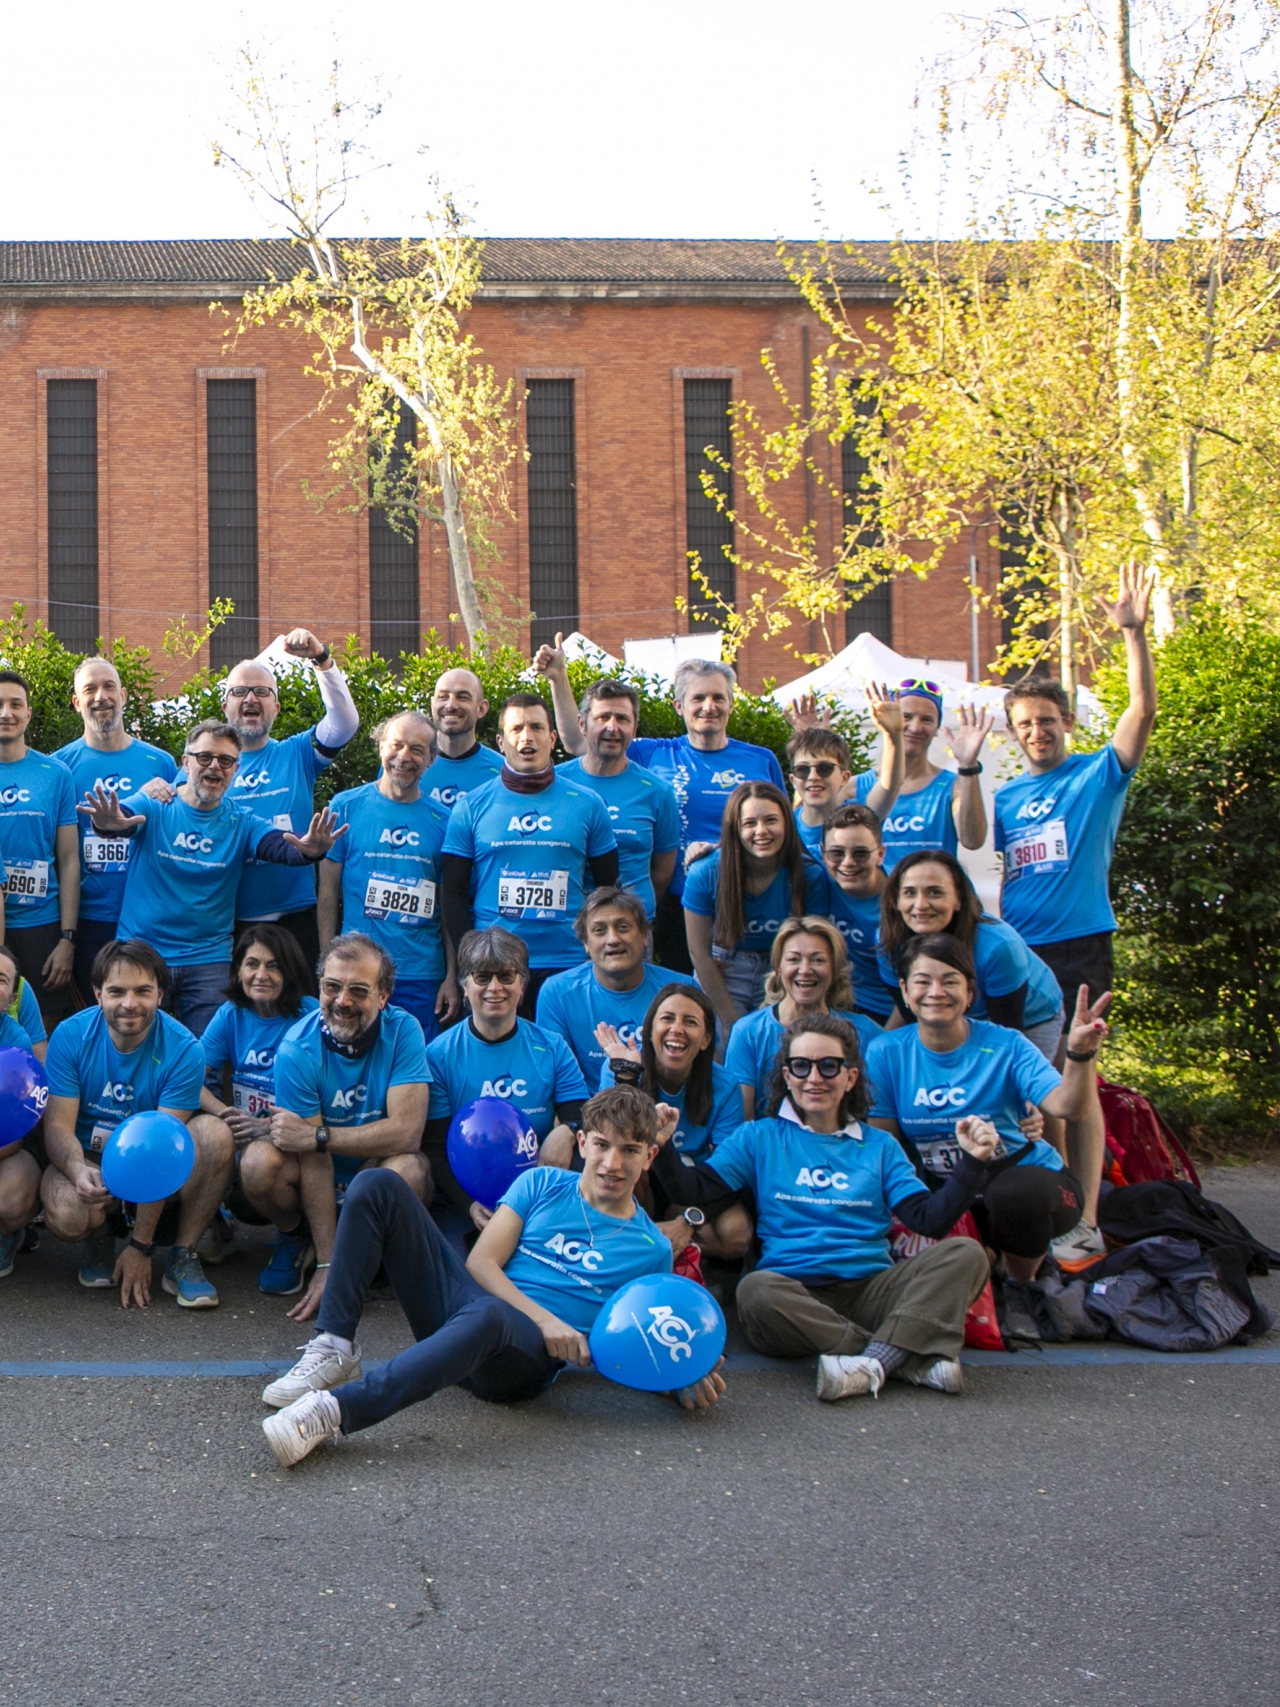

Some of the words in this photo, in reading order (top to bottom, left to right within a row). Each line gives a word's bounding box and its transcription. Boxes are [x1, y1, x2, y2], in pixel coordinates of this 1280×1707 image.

[1015, 843, 1047, 866] 381D
[380, 889, 420, 913] 382B
[515, 886, 554, 907] 372B
[744, 919, 780, 934] CC
[244, 1049, 276, 1067] AC
[29, 1085, 49, 1107] AC
[248, 1094, 276, 1113] 371
[516, 1131, 539, 1156] AC
[939, 1147, 963, 1170] 37
[647, 1305, 694, 1363] ACC
